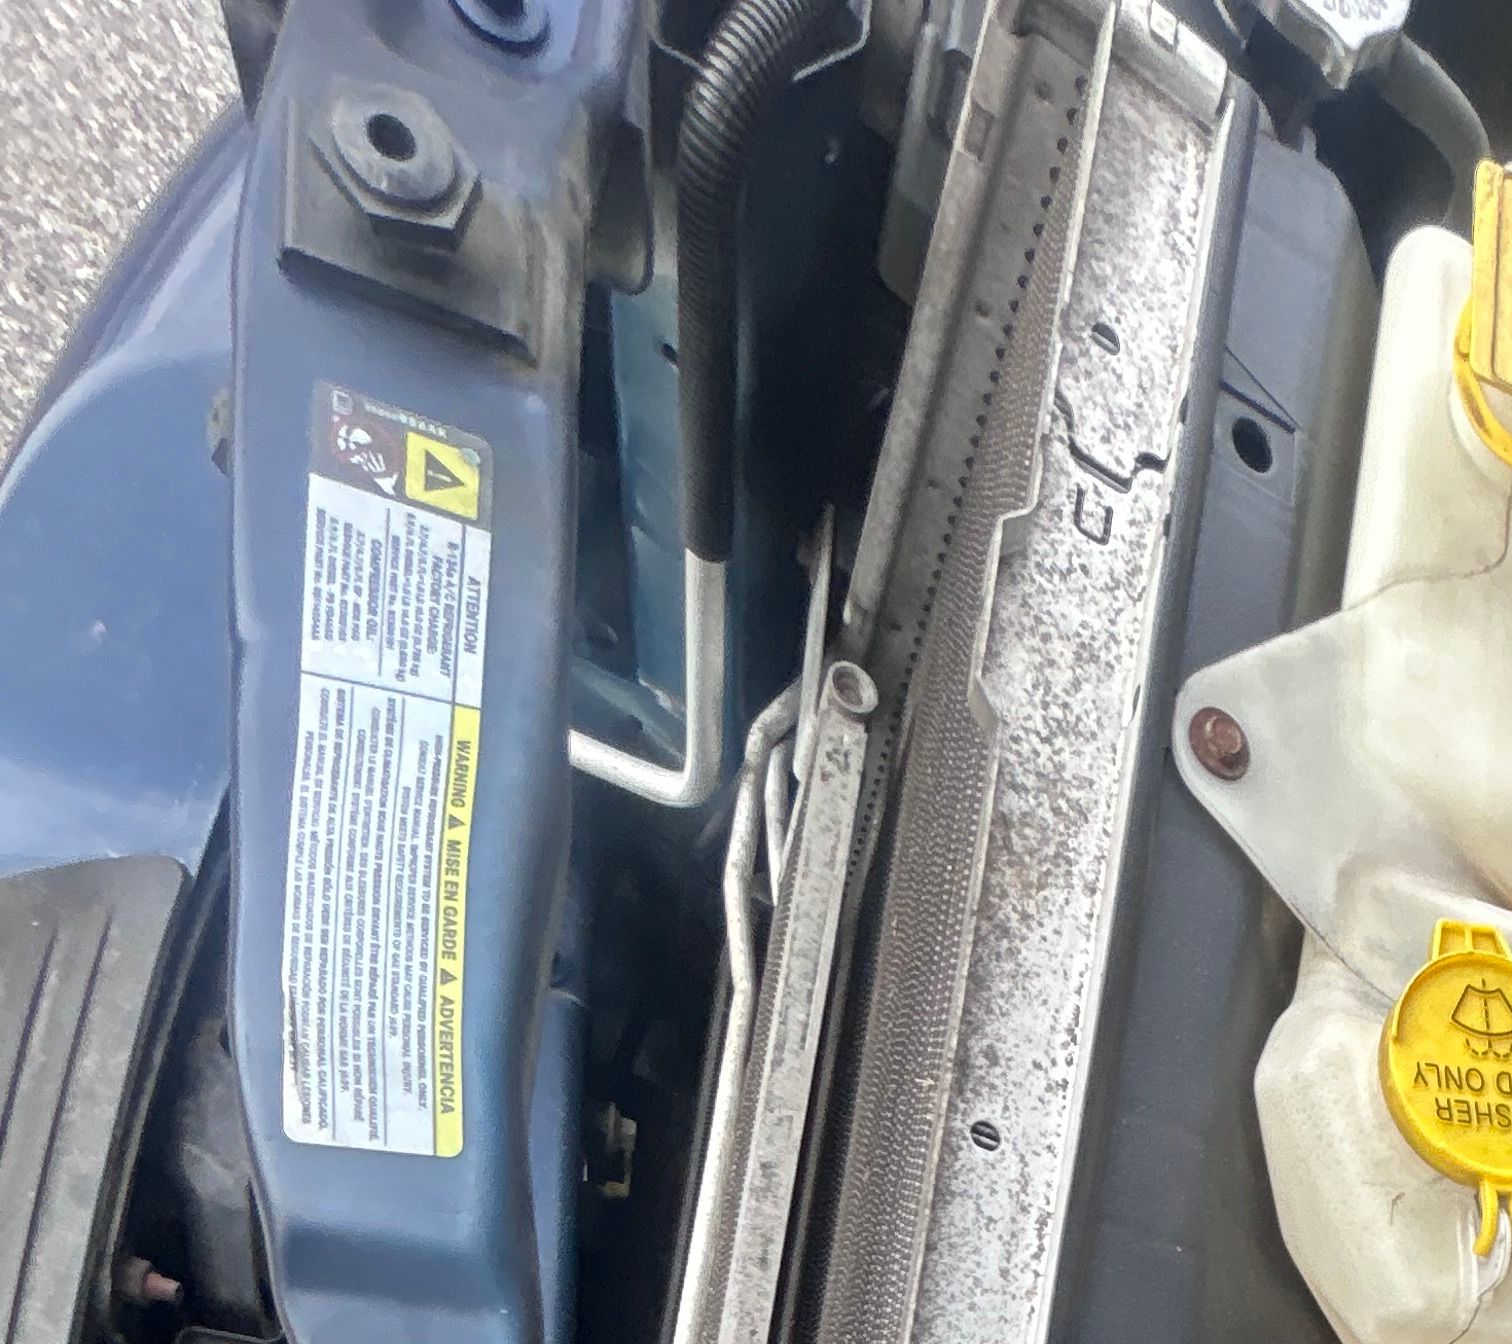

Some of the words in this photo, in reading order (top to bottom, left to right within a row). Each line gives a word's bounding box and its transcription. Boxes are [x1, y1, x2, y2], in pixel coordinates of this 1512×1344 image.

[368, 538, 383, 617] COMPRESSOR
[429, 555, 444, 606] FACTORY
[426, 606, 441, 656] CHARGE:
[463, 575, 482, 655] ATTENTION
[440, 603, 456, 680] REFRIGERANT
[450, 739, 472, 809] WARNING
[423, 854, 433, 889] SYSTEM
[444, 839, 462, 878] MISE
[421, 890, 431, 903] TO
[421, 903, 430, 915] BE
[442, 879, 459, 903] EN
[419, 916, 430, 960] SERVICED
[441, 904, 459, 962] GARDE
[418, 961, 428, 973] BY
[417, 974, 428, 1022] QUALIFIED
[417, 1023, 427, 1081] PERSONNEL
[439, 995, 456, 1115] ADVERTENCIA
[1412, 1060, 1487, 1093] ONLY
